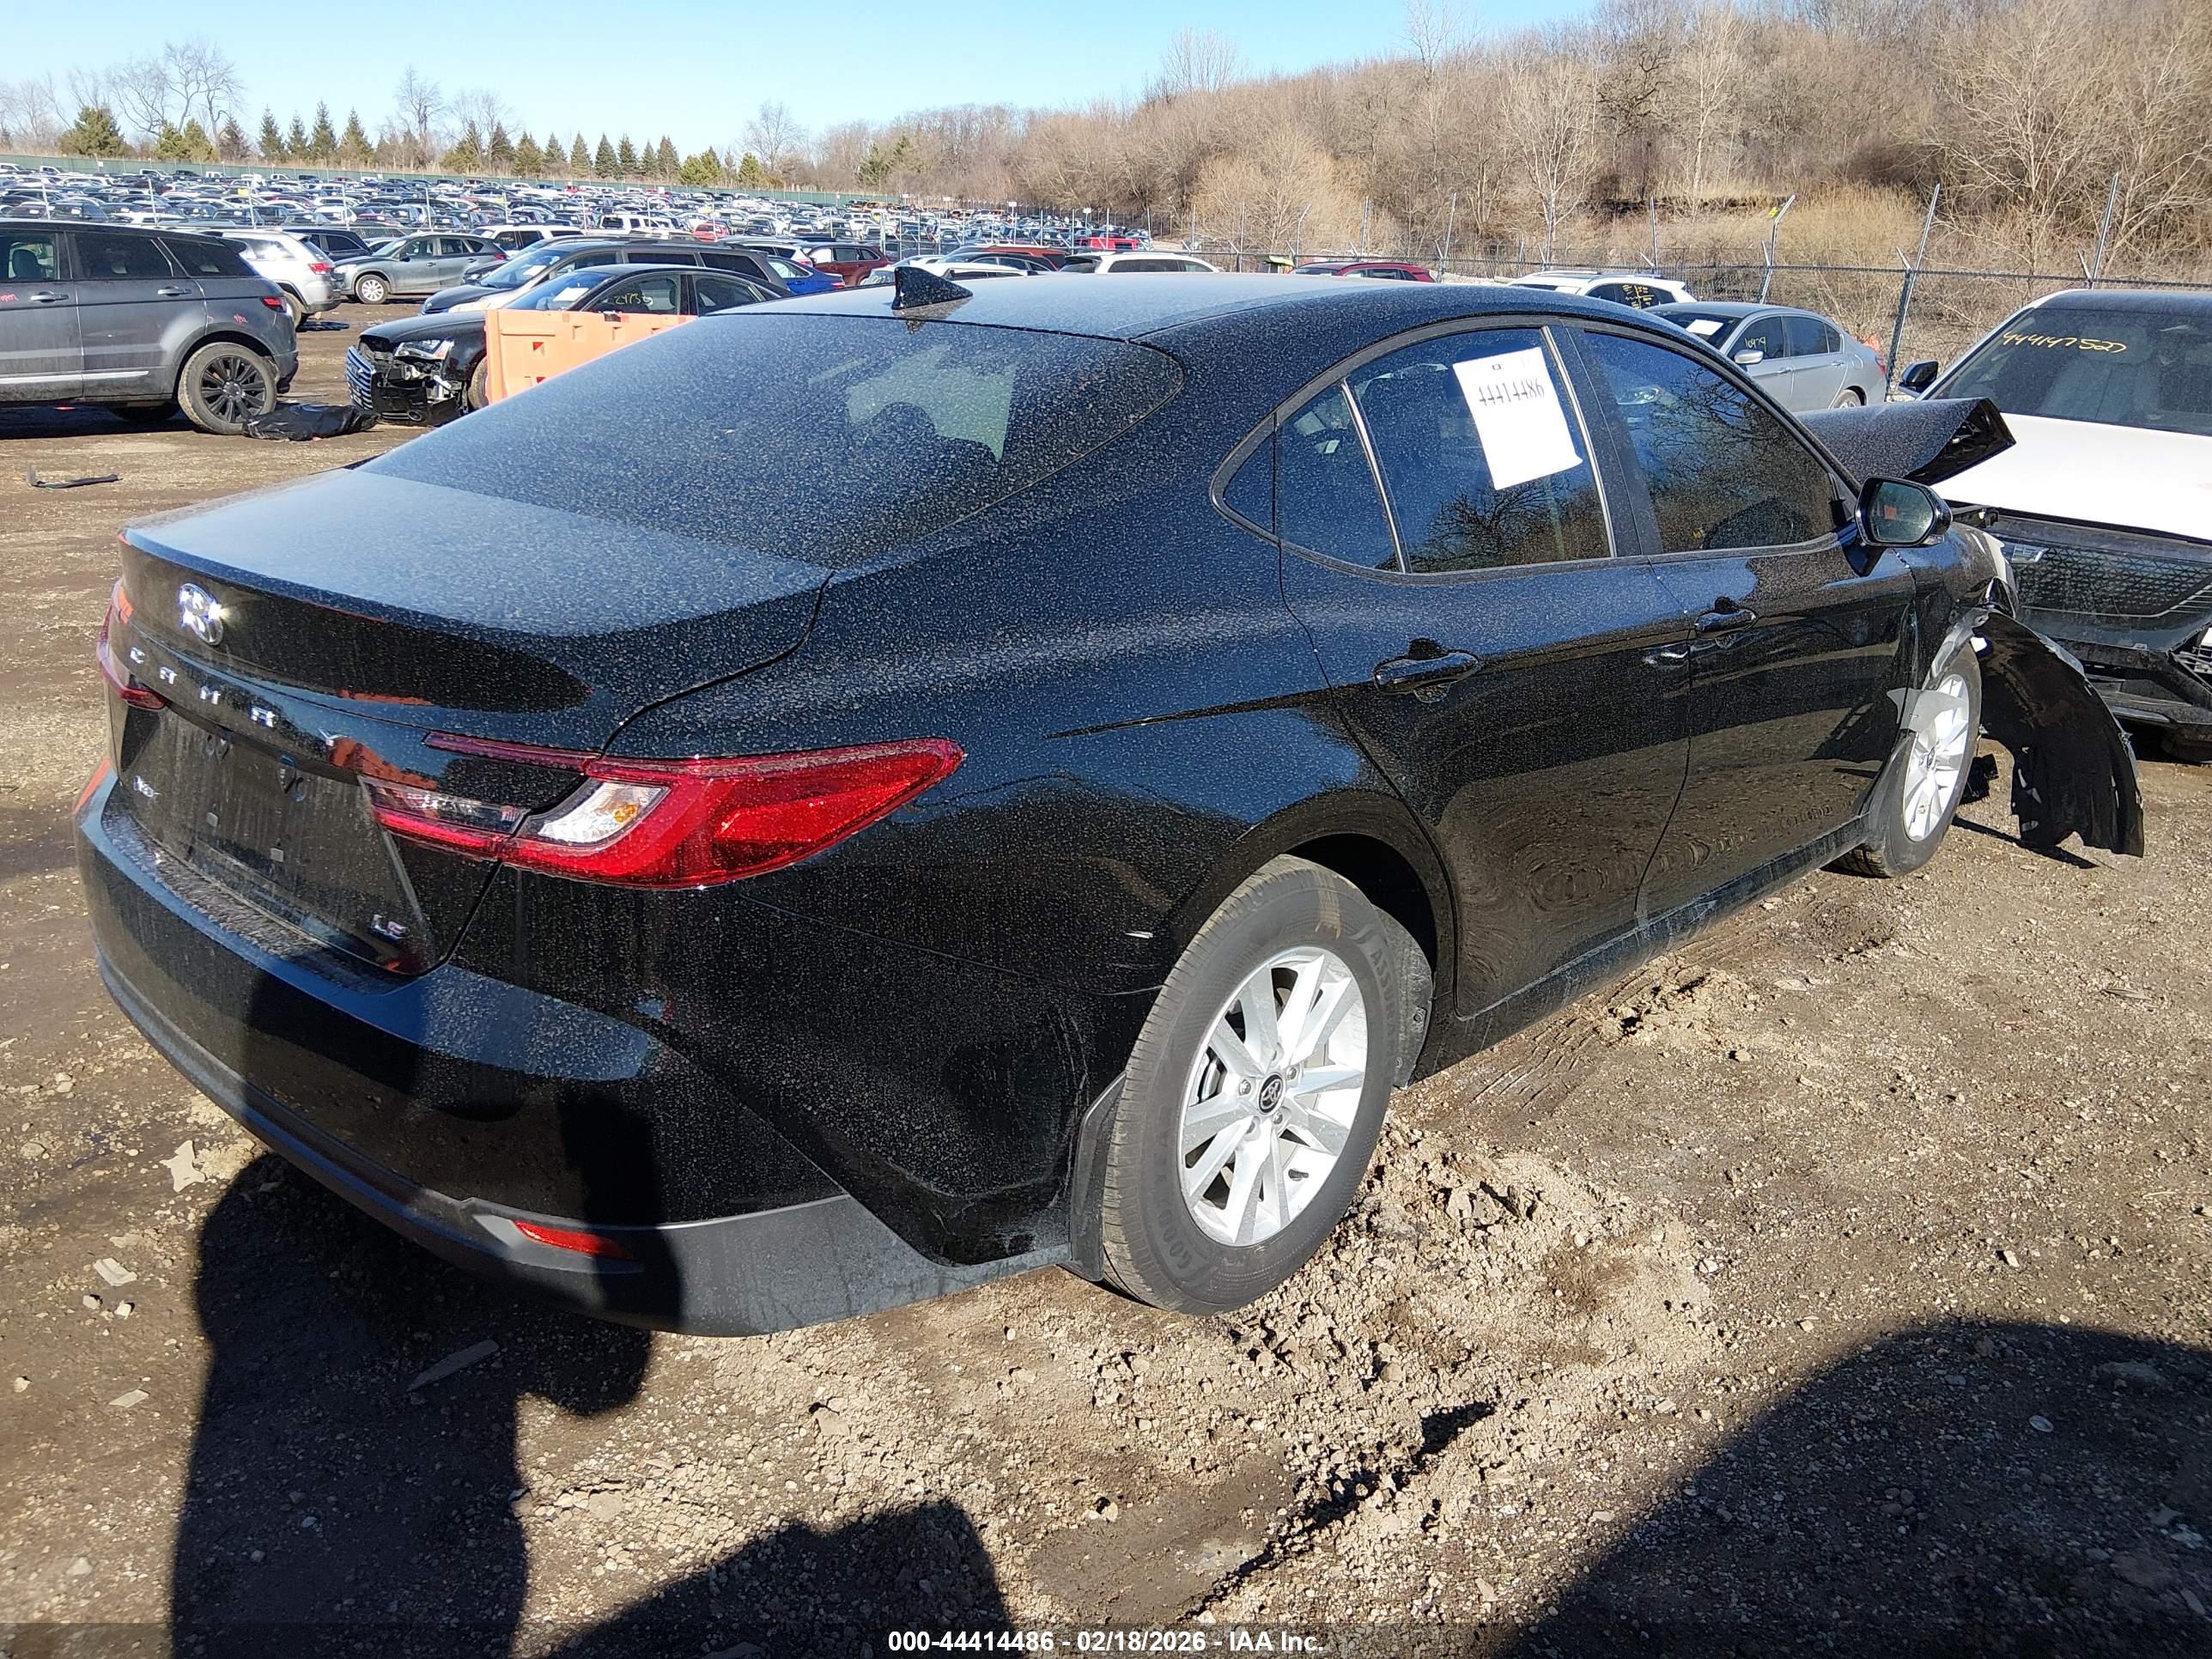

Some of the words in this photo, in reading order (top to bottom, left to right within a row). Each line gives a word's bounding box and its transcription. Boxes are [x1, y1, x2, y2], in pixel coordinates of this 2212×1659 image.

[1478, 378, 1545, 406] 44414486
[130, 647, 348, 747] CAMRY
[371, 914, 406, 940] LE
